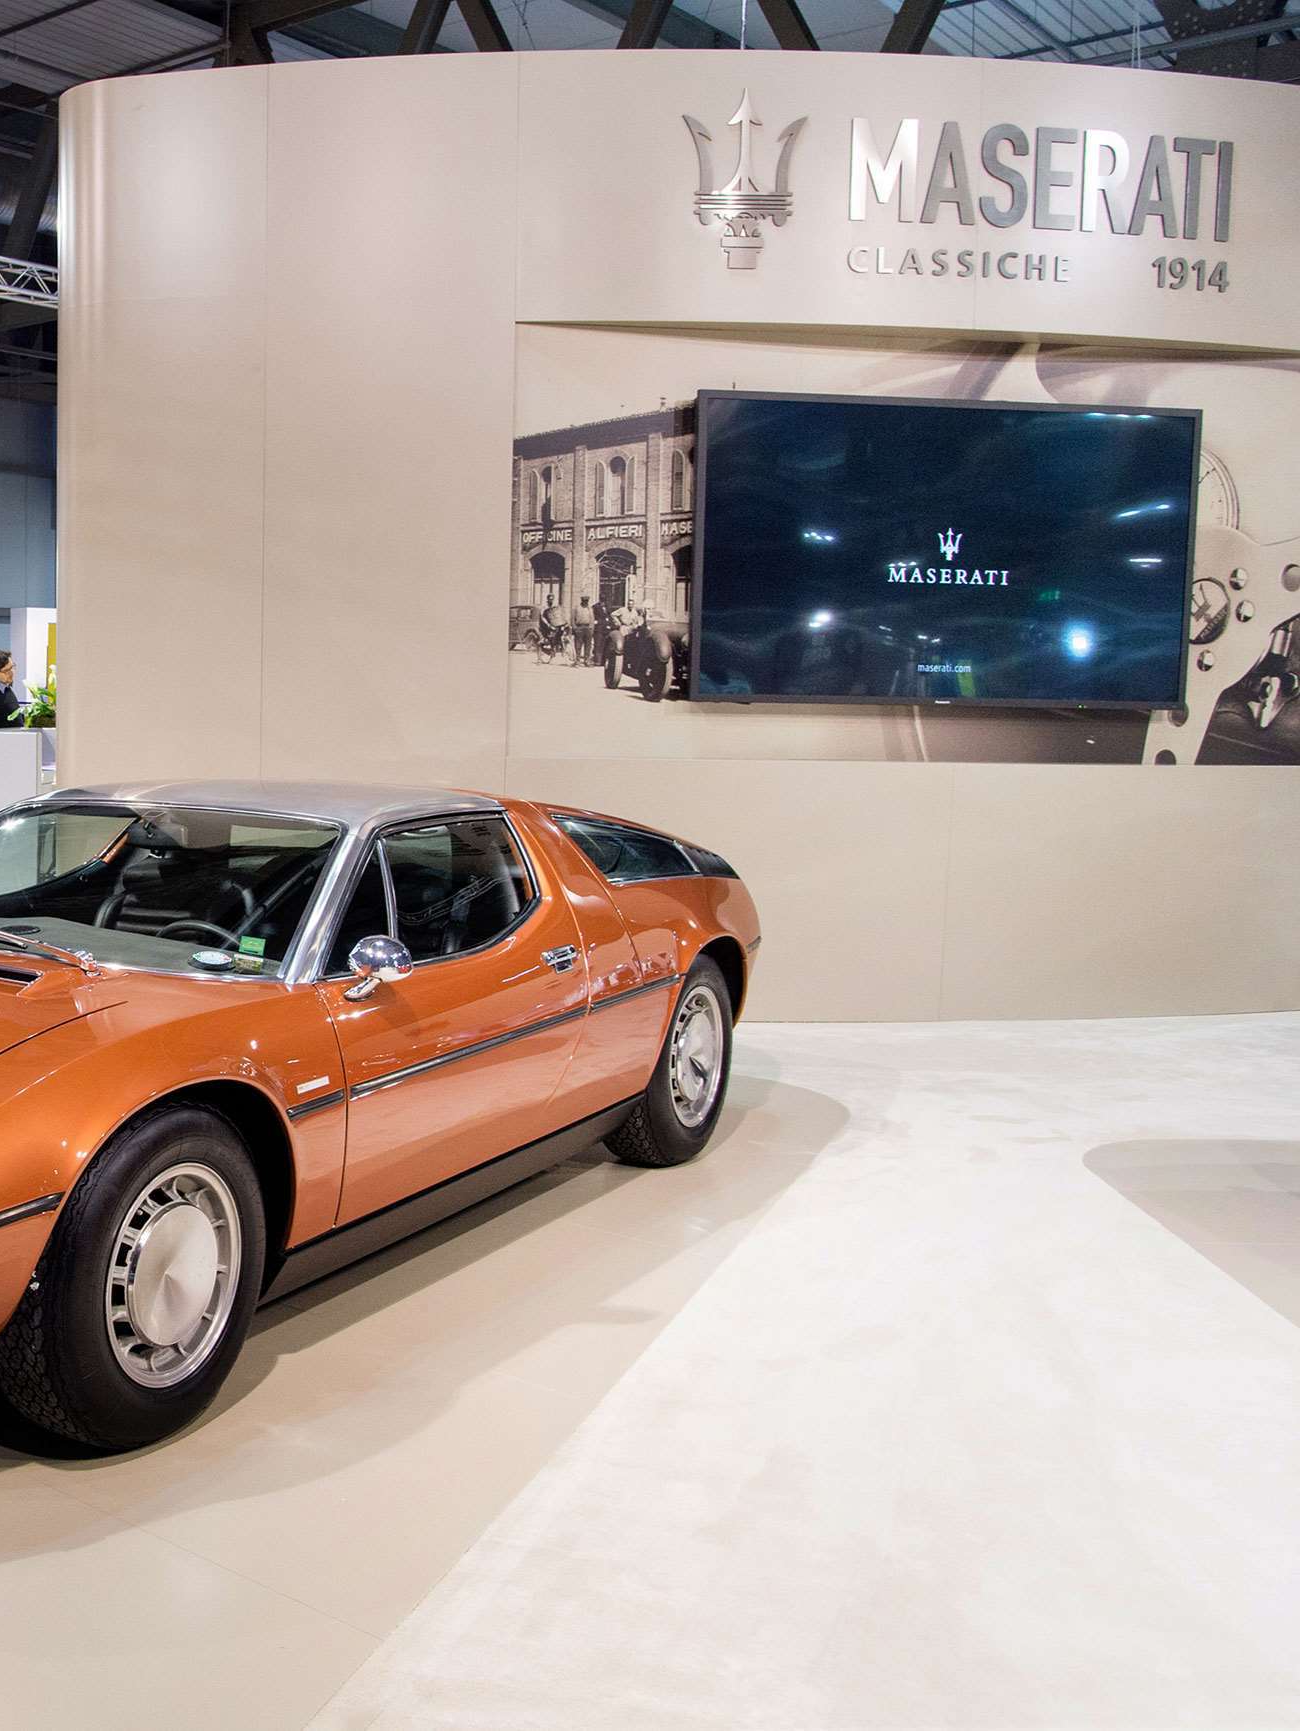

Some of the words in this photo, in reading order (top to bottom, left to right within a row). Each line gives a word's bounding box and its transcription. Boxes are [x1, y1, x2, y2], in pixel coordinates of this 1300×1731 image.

[848, 117, 1234, 242] MASERATI
[847, 246, 1071, 283] CLASSICHE
[1152, 255, 1231, 293] 1914
[522, 529, 573, 544] OFFCINE
[587, 524, 643, 541] ALFIERI
[887, 567, 1009, 586] MASERATI
[917, 662, 972, 673] maserati.com
